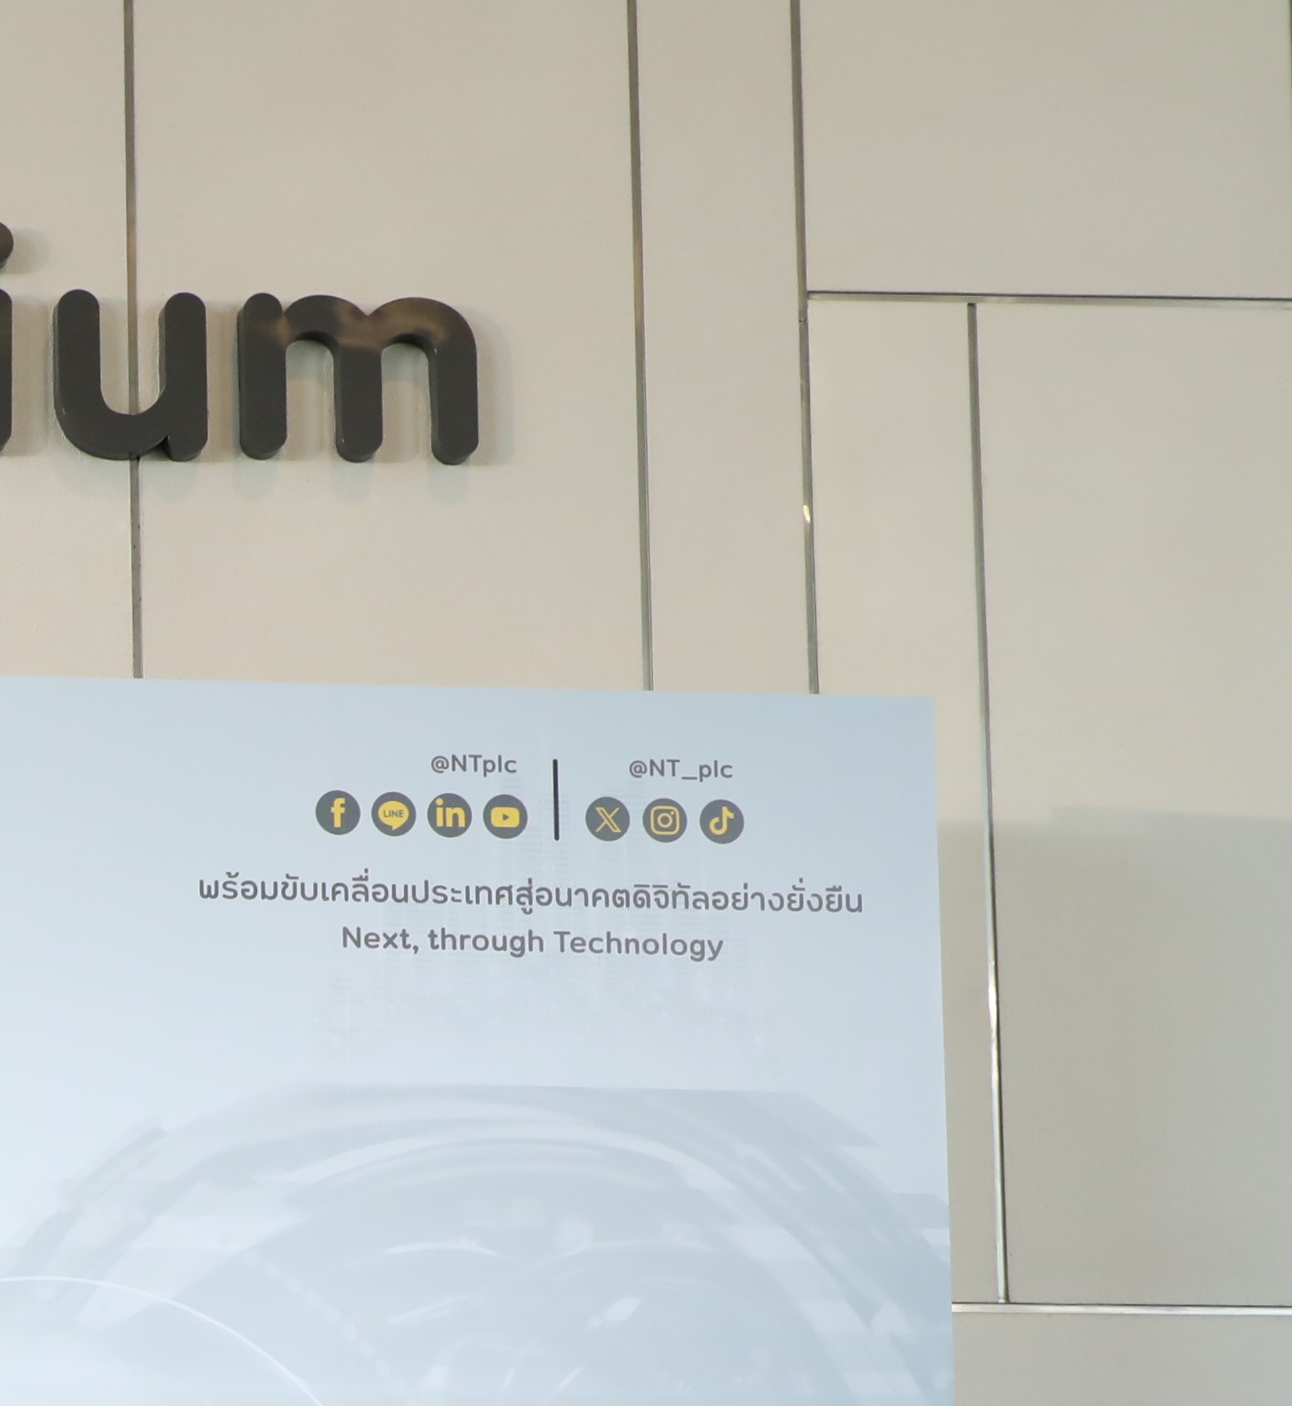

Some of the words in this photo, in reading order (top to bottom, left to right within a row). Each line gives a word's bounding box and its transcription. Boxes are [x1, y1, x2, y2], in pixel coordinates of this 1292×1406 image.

[430, 754, 518, 778] @NTplc
[628, 758, 734, 783] @NT_plc
[383, 809, 405, 818] LINE
[198, 867, 864, 915] พร้อมขับเคลื่อนประเทศสู่อนาคตดิจิทัลอย่างยั่งยืน
[342, 926, 419, 955] Next,
[427, 927, 545, 958] through
[553, 930, 724, 963] Technology
